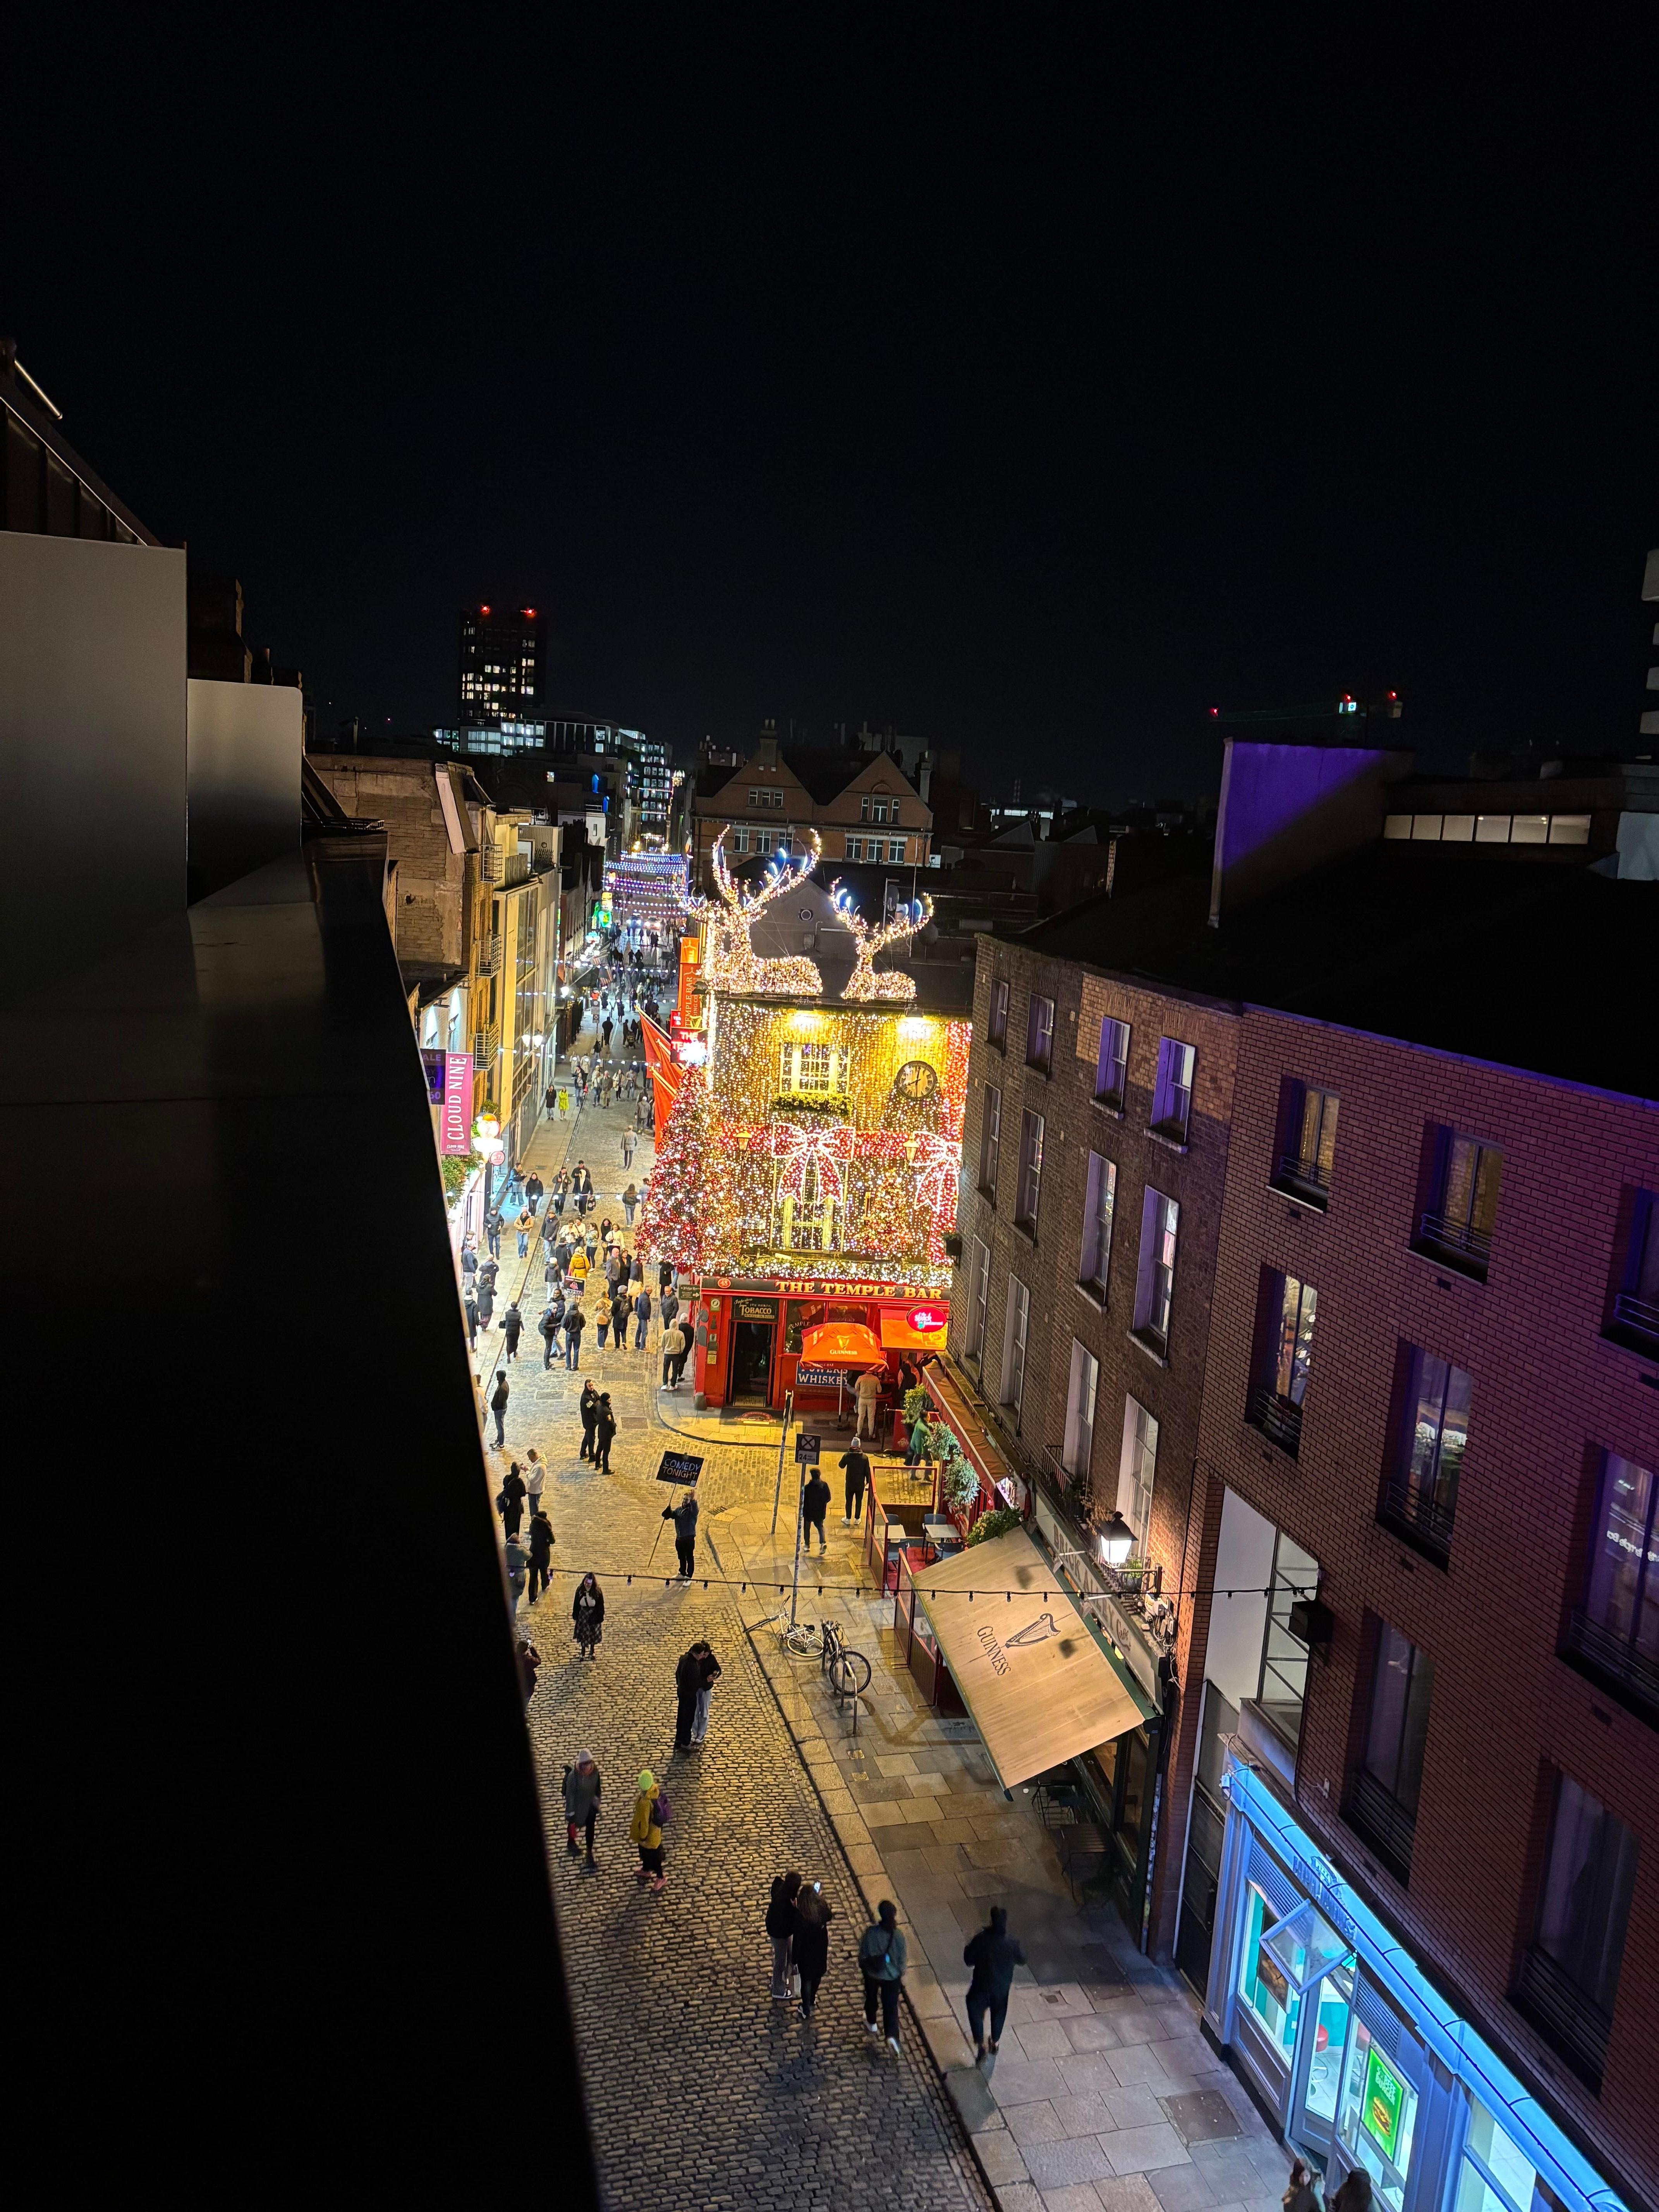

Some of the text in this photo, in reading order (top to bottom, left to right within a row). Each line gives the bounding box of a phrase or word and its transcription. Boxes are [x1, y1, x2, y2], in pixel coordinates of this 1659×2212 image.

[448, 1056, 467, 1090] NINE
[447, 1094, 465, 1140] CLOUD
[775, 1281, 942, 1299] THE TEMPLE BAR
[739, 1304, 772, 1316] TOBACCO
[798, 1373, 848, 1385] WHISKEY
[663, 1466, 697, 1479] TONIGHT
[664, 1459, 701, 1472] COMEDY
[1053, 1522, 1081, 1582] BRICK
[977, 1626, 1011, 1676] GUINNESS
